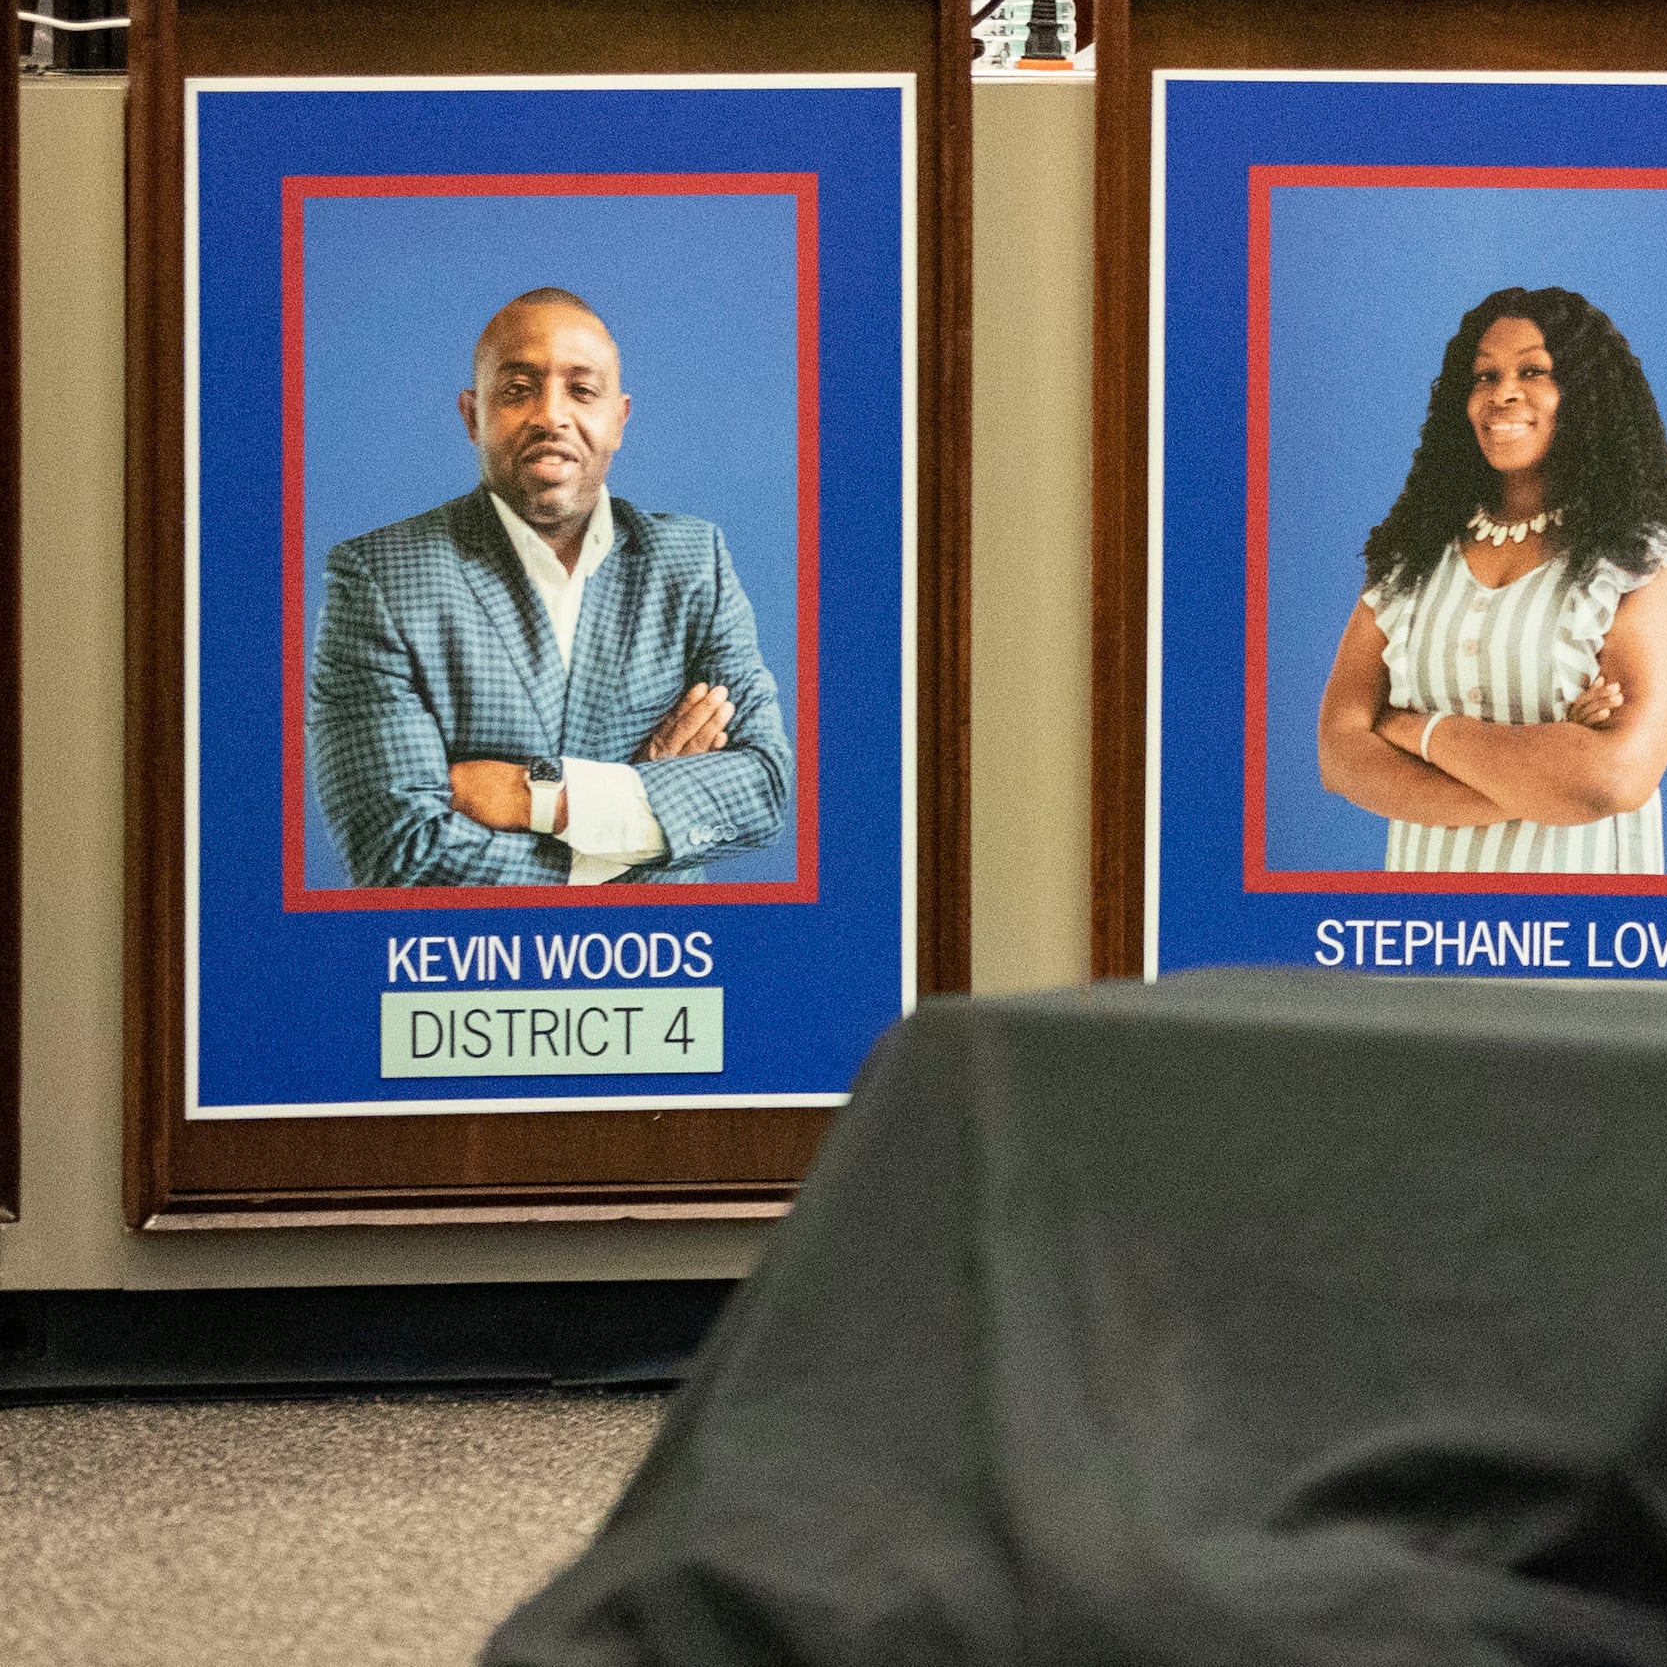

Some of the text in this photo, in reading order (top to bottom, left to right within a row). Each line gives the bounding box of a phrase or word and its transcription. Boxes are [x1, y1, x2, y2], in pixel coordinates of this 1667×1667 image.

[387, 930, 714, 984] KEVIN WOODS
[1314, 918, 1571, 968] STEPHANIE
[410, 1005, 696, 1060] DISTRICT 4
